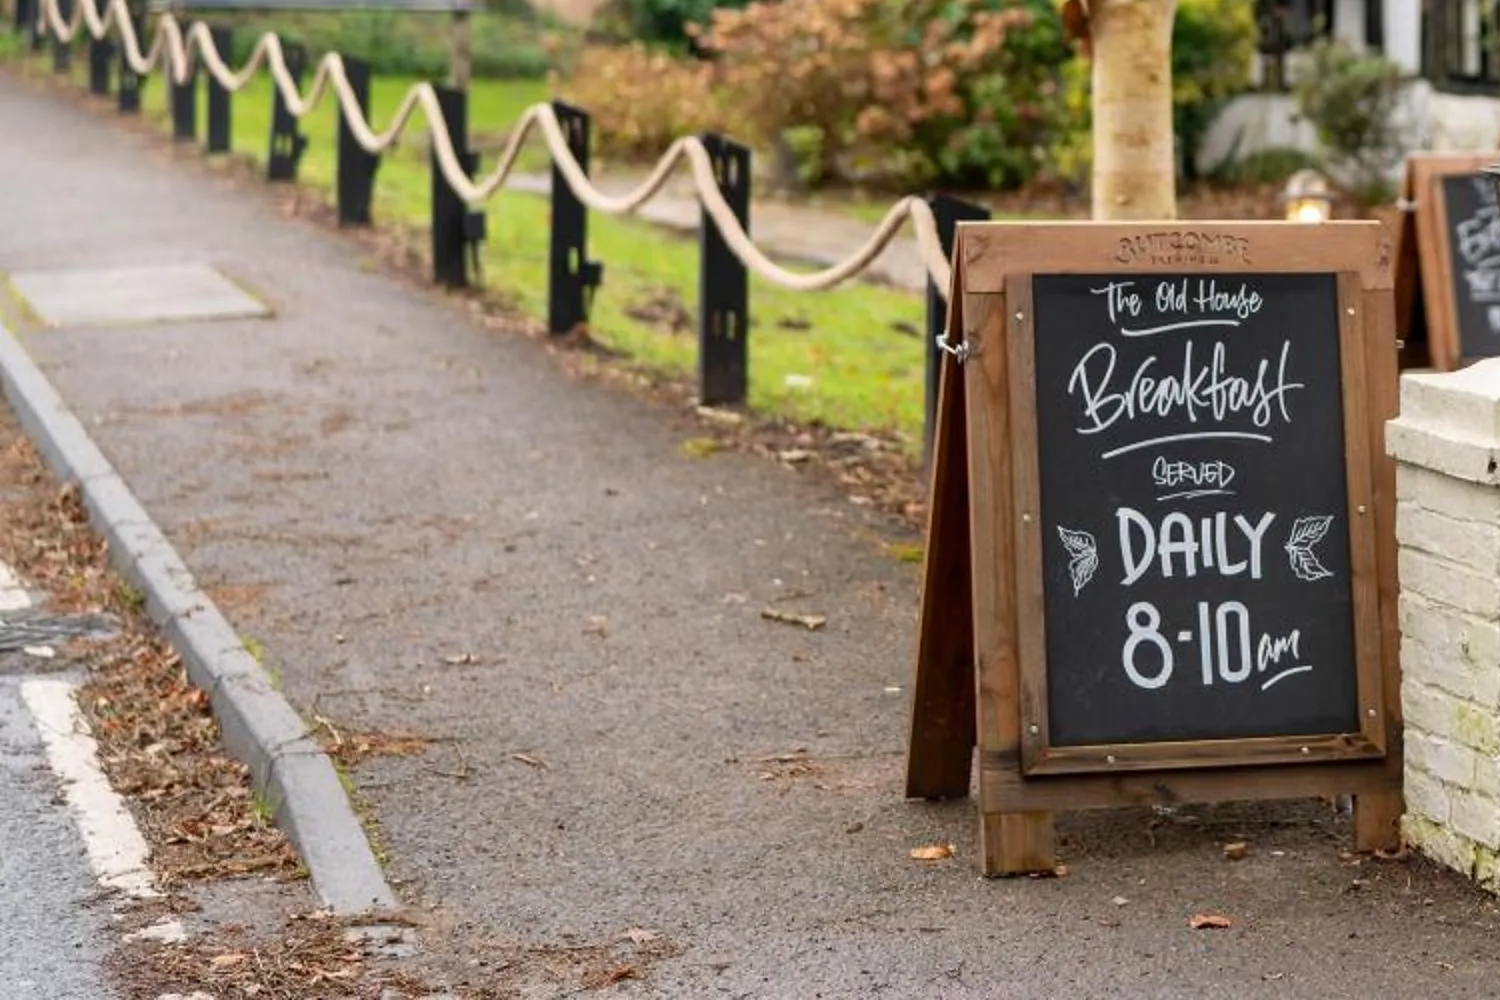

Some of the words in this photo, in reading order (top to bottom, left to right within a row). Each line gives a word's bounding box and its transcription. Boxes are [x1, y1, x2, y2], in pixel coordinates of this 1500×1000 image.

[1091, 281, 1142, 324] The
[1155, 277, 1189, 315] Old
[1192, 279, 1263, 319] House
[1068, 339, 1305, 434] Breakfast
[1152, 456, 1235, 488] SERVED
[1115, 507, 1276, 586] DAILY
